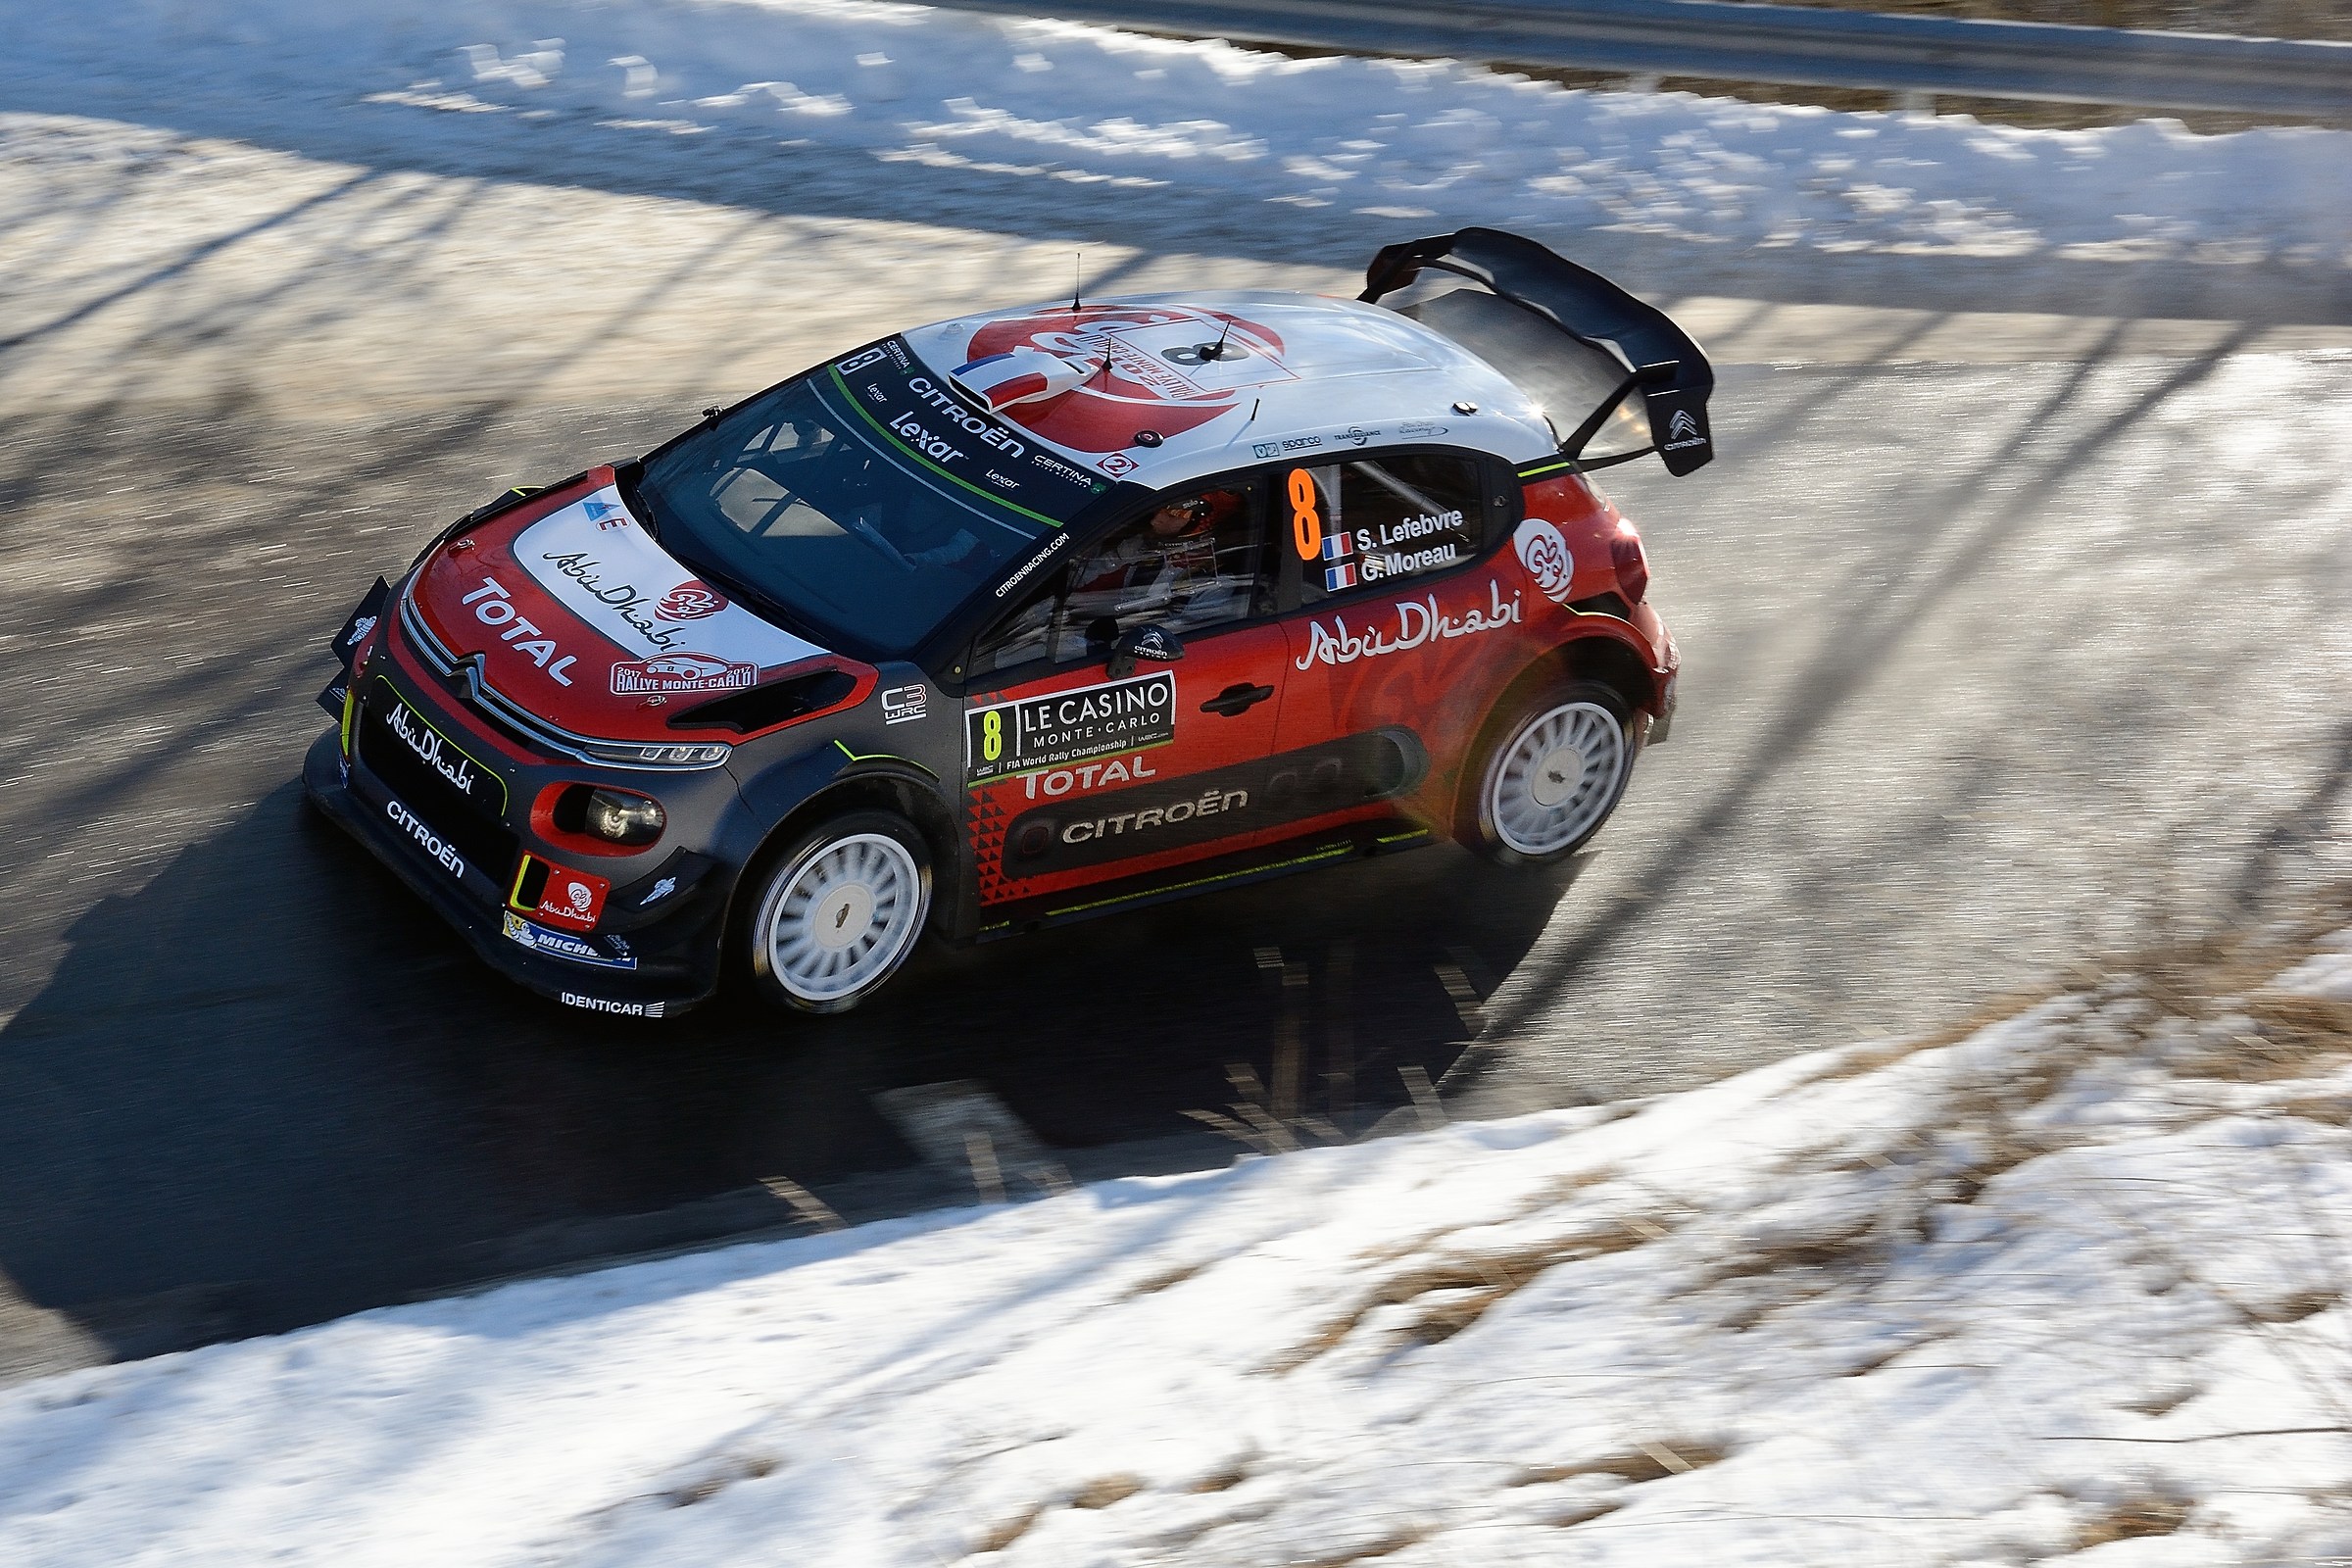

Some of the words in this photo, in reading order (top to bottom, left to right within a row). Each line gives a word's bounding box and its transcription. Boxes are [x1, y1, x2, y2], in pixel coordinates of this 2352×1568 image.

[841, 351, 881, 370] 8
[886, 340, 910, 368] CERTINA
[1161, 342, 1250, 366] 8
[867, 382, 888, 403] Lexar
[908, 377, 1025, 459] CITROËN
[889, 411, 964, 463] Lexar
[1282, 436, 1321, 449] sparco
[985, 468, 1020, 489] Lexar
[1034, 455, 1092, 485] CERTINA
[1288, 467, 1321, 561] 8
[1356, 528, 1377, 551] S.
[1380, 510, 1463, 545] Lefebvre
[996, 532, 1069, 598] CITROENRACING.COM
[462, 576, 578, 687] TOTAL
[616, 672, 659, 692] RALLYE
[662, 670, 752, 690] MONTE-CARLO
[617, 666, 642, 678] 2017
[726, 666, 751, 677] 2017
[882, 684, 926, 710] C3
[885, 705, 926, 719] WRC
[1024, 706, 1052, 732] LE
[1059, 683, 1168, 725] CASINO
[983, 710, 1002, 761] 8
[1006, 760, 1020, 769] FIA
[1022, 755, 1047, 766] World
[1049, 752, 1070, 762] Rally
[1071, 739, 1127, 758] Championship
[1016, 756, 1155, 800] TOTAL
[1062, 789, 1249, 845] CITROËN
[386, 800, 466, 878] CITROËN
[562, 992, 643, 1015] IDENTICAR
